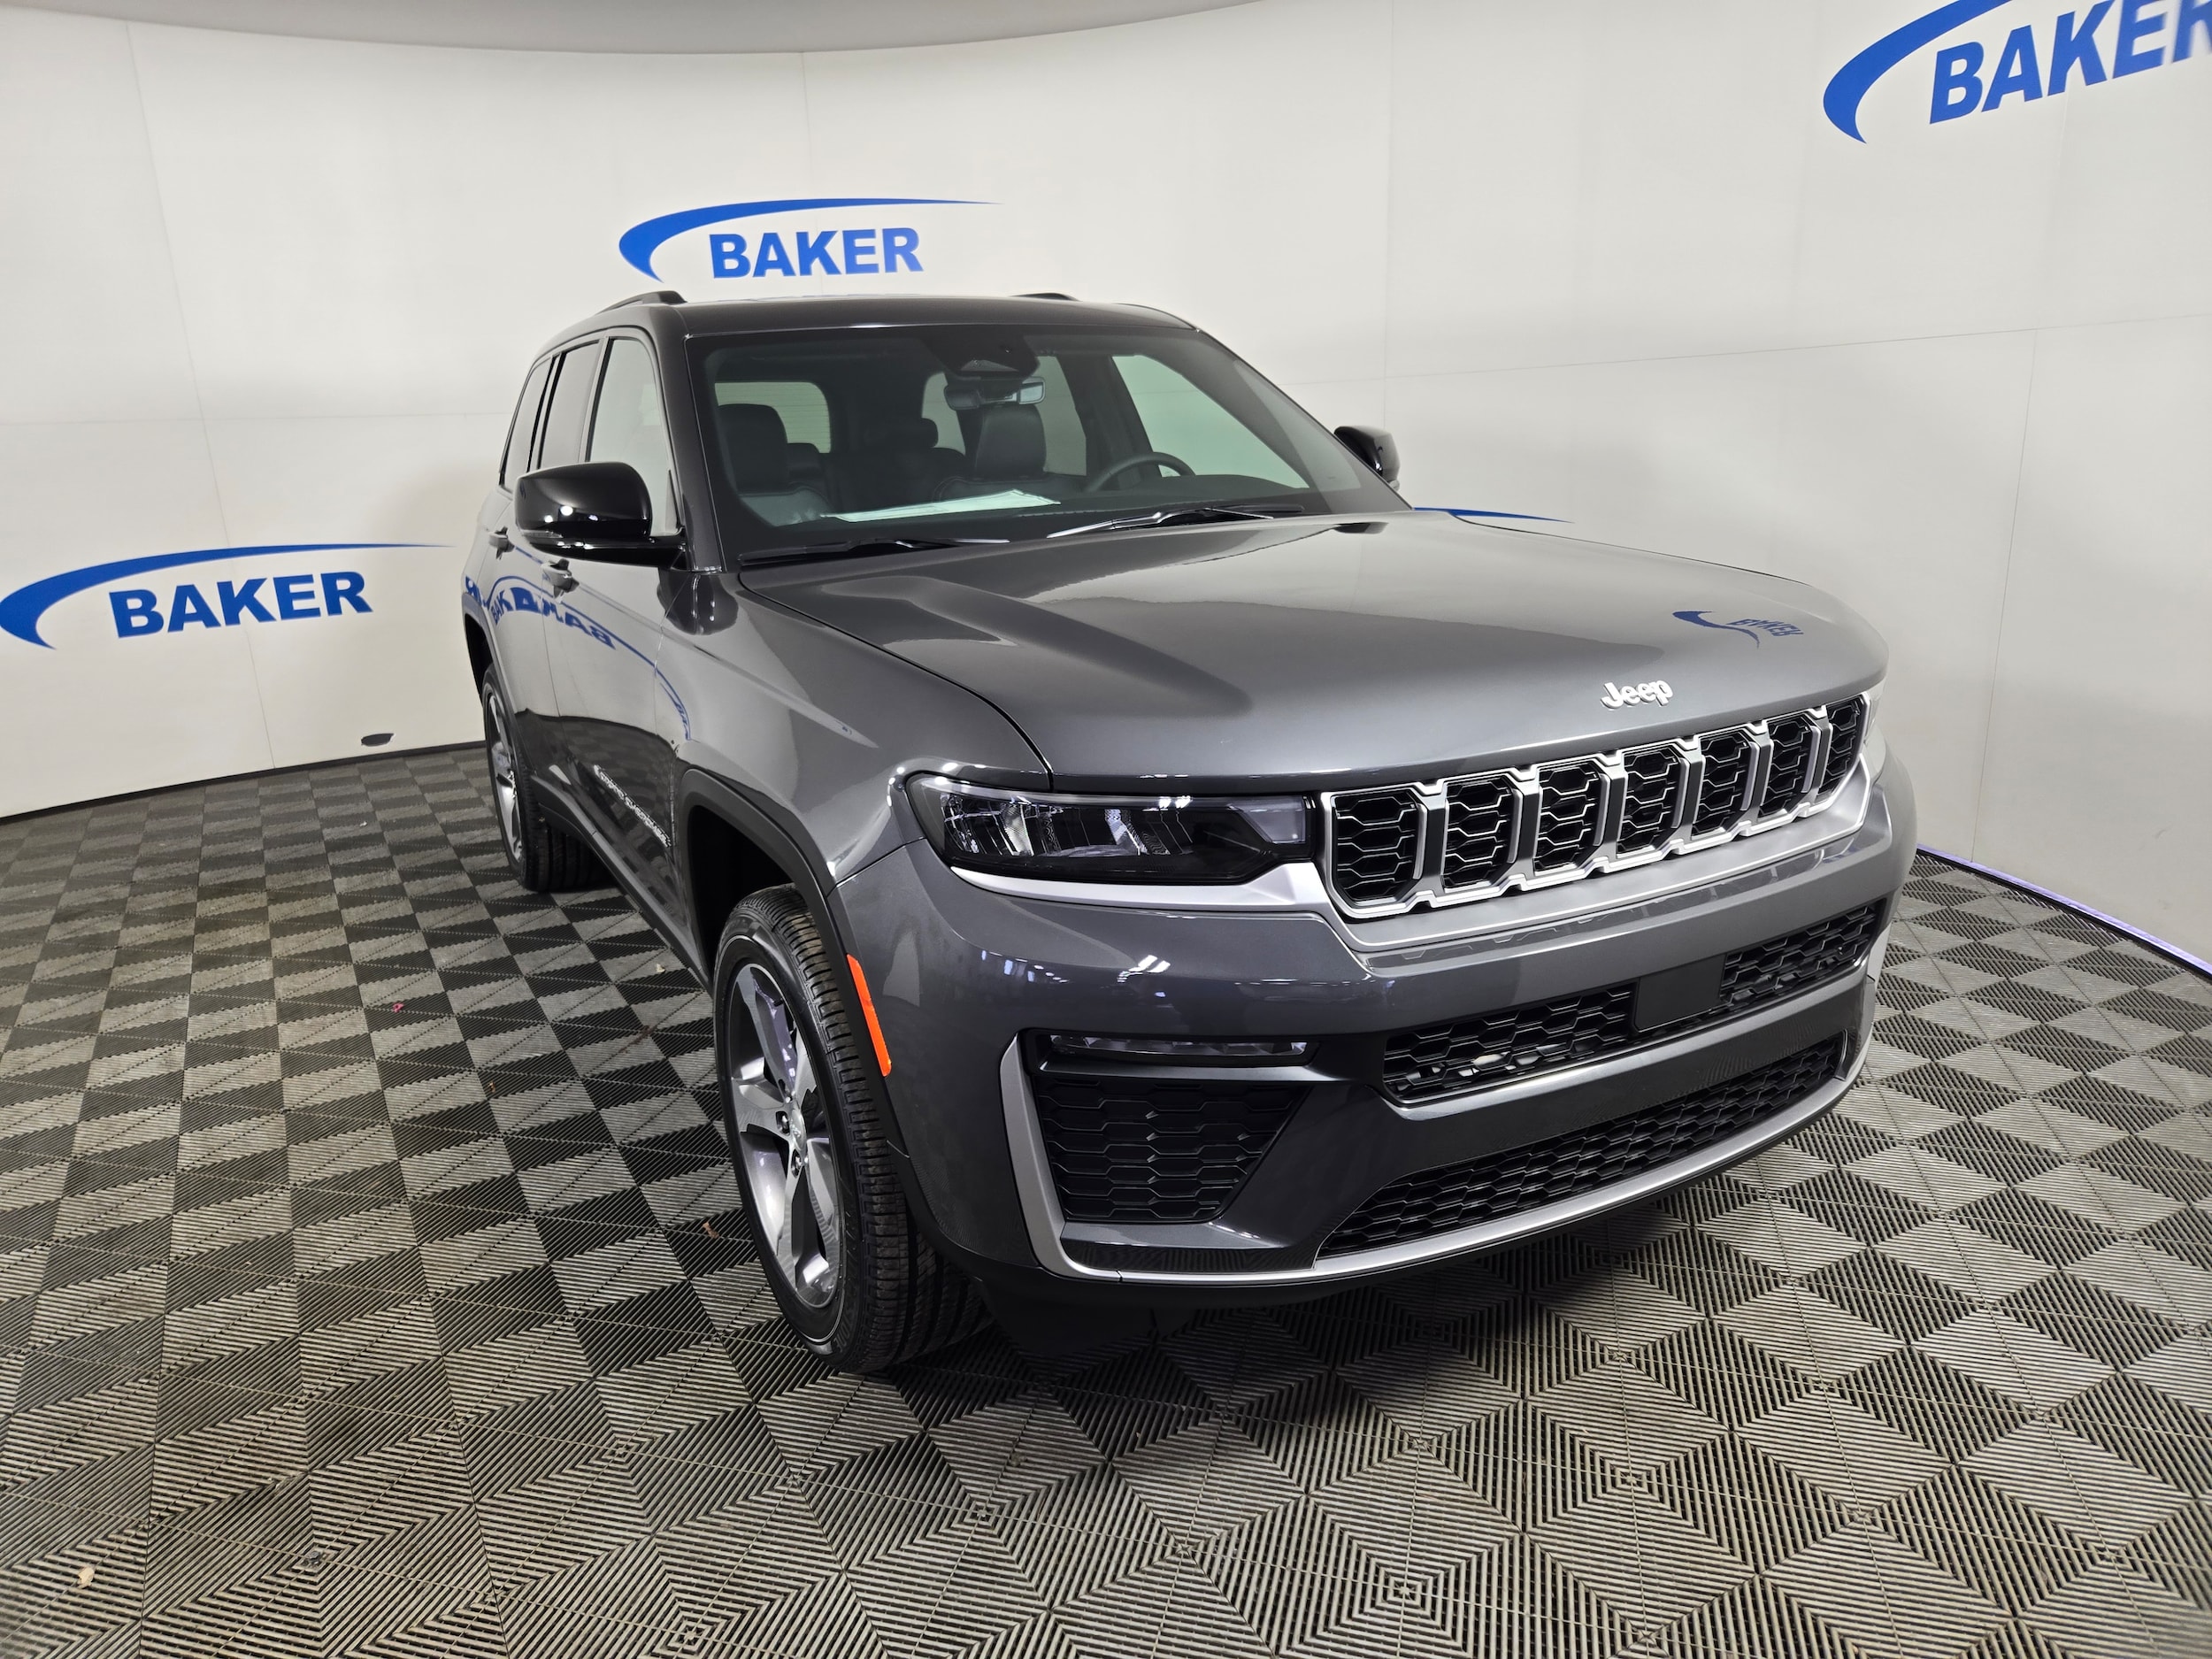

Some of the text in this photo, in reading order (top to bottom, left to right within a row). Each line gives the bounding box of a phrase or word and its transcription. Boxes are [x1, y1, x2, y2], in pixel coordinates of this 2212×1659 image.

[709, 227, 924, 279] BAKER
[109, 571, 373, 638] BAKER
[1600, 680, 1674, 710] Jeep
